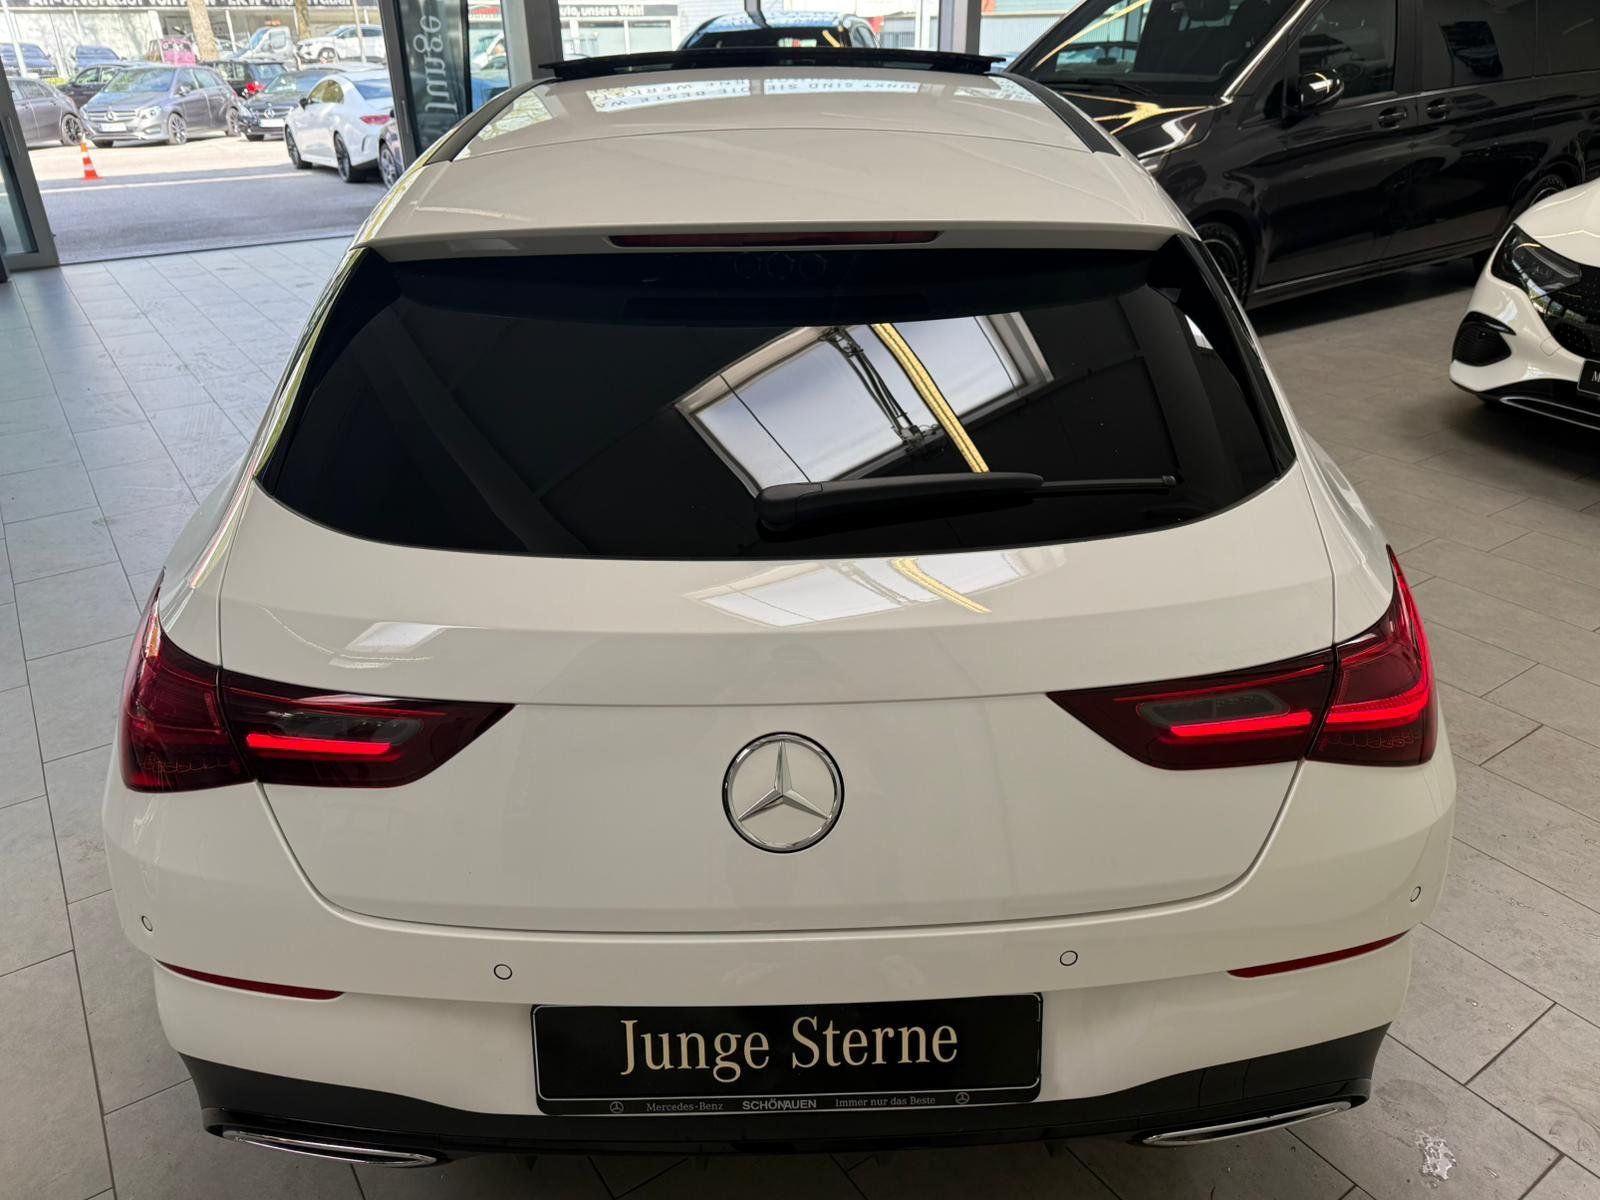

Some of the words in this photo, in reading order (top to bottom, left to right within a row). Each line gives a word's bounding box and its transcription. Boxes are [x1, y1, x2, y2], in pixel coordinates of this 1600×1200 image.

[620, 1018, 771, 1084] Junge
[791, 1016, 959, 1070] Sterne
[646, 1101, 725, 1112] Mercedes-Benz
[742, 1098, 818, 1111] SCHÖNAUEN
[835, 1098, 868, 1108] Immer
[870, 1098, 889, 1107] nur
[890, 1096, 907, 1106] das
[909, 1095, 937, 1105] Beste
